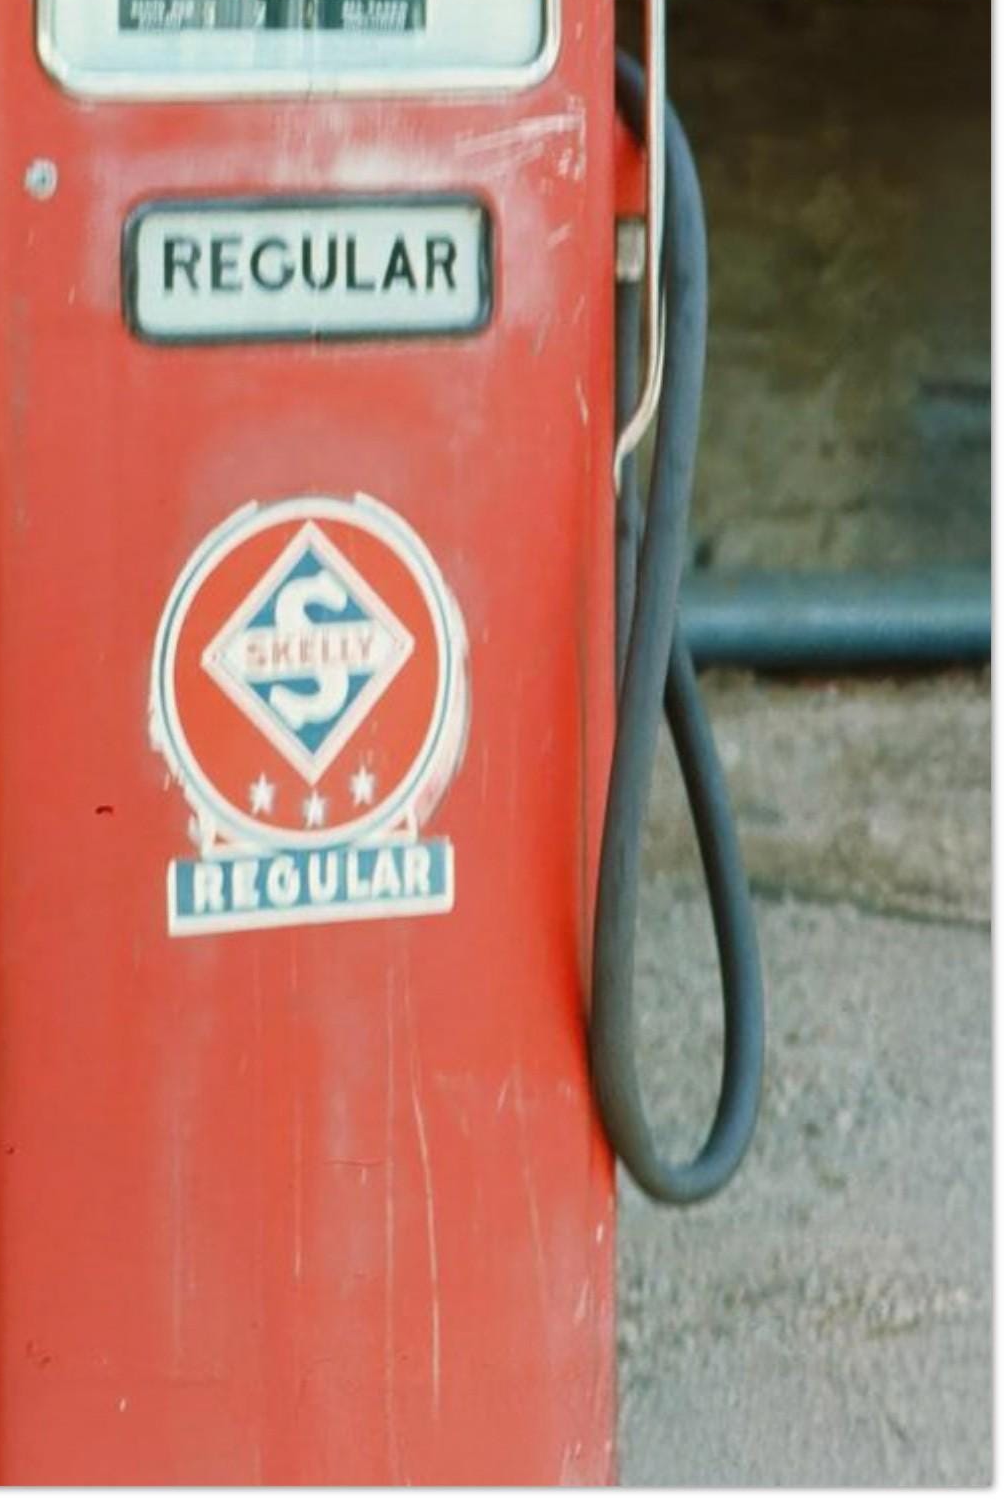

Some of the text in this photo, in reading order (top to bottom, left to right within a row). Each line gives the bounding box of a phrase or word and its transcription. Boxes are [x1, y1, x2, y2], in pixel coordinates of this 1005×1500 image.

[162, 233, 457, 293] REGULAR
[245, 632, 375, 669] SKELLY
[193, 842, 432, 914] REGULAR
